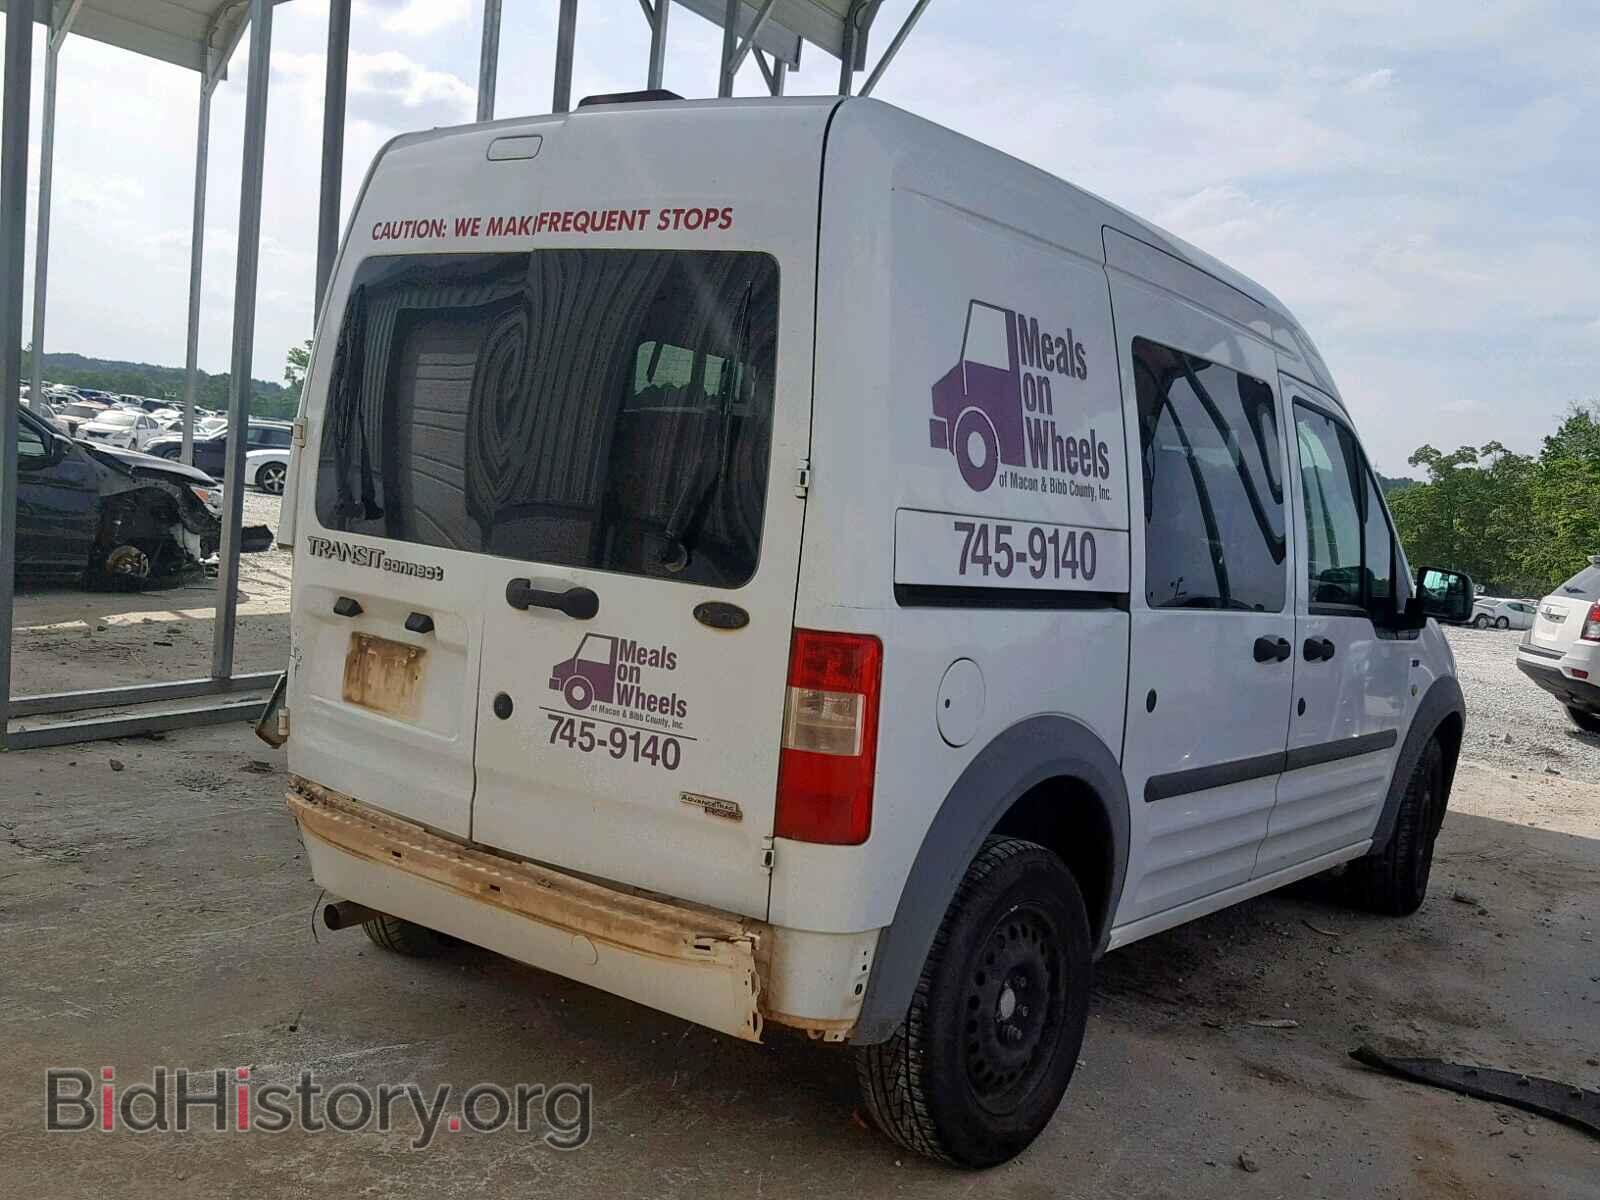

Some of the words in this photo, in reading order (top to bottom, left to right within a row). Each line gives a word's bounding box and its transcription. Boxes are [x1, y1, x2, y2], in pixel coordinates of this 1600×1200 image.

[371, 221, 447, 240] CAUTION:
[454, 217, 480, 237] WE
[486, 215, 539, 237] MAK
[537, 209, 650, 234] FREQUENT
[656, 207, 733, 231] STOPS
[1018, 313, 1088, 381] Meals
[1022, 372, 1053, 416] on
[1025, 416, 1110, 480] Wheels
[999, 471, 1007, 488] of
[1010, 471, 1038, 492] Macon
[1040, 476, 1047, 493] &
[1049, 477, 1068, 495] Bibb
[1069, 480, 1097, 502] County,
[307, 536, 385, 568] TRANSIT
[381, 557, 444, 581] connect
[954, 521, 1097, 581] 745-9140
[616, 661, 641, 684] on
[618, 638, 677, 671] Meals
[591, 704, 597, 712] of
[599, 704, 620, 716] Macon
[615, 682, 688, 718] Wheels
[547, 713, 682, 771] 745-9140
